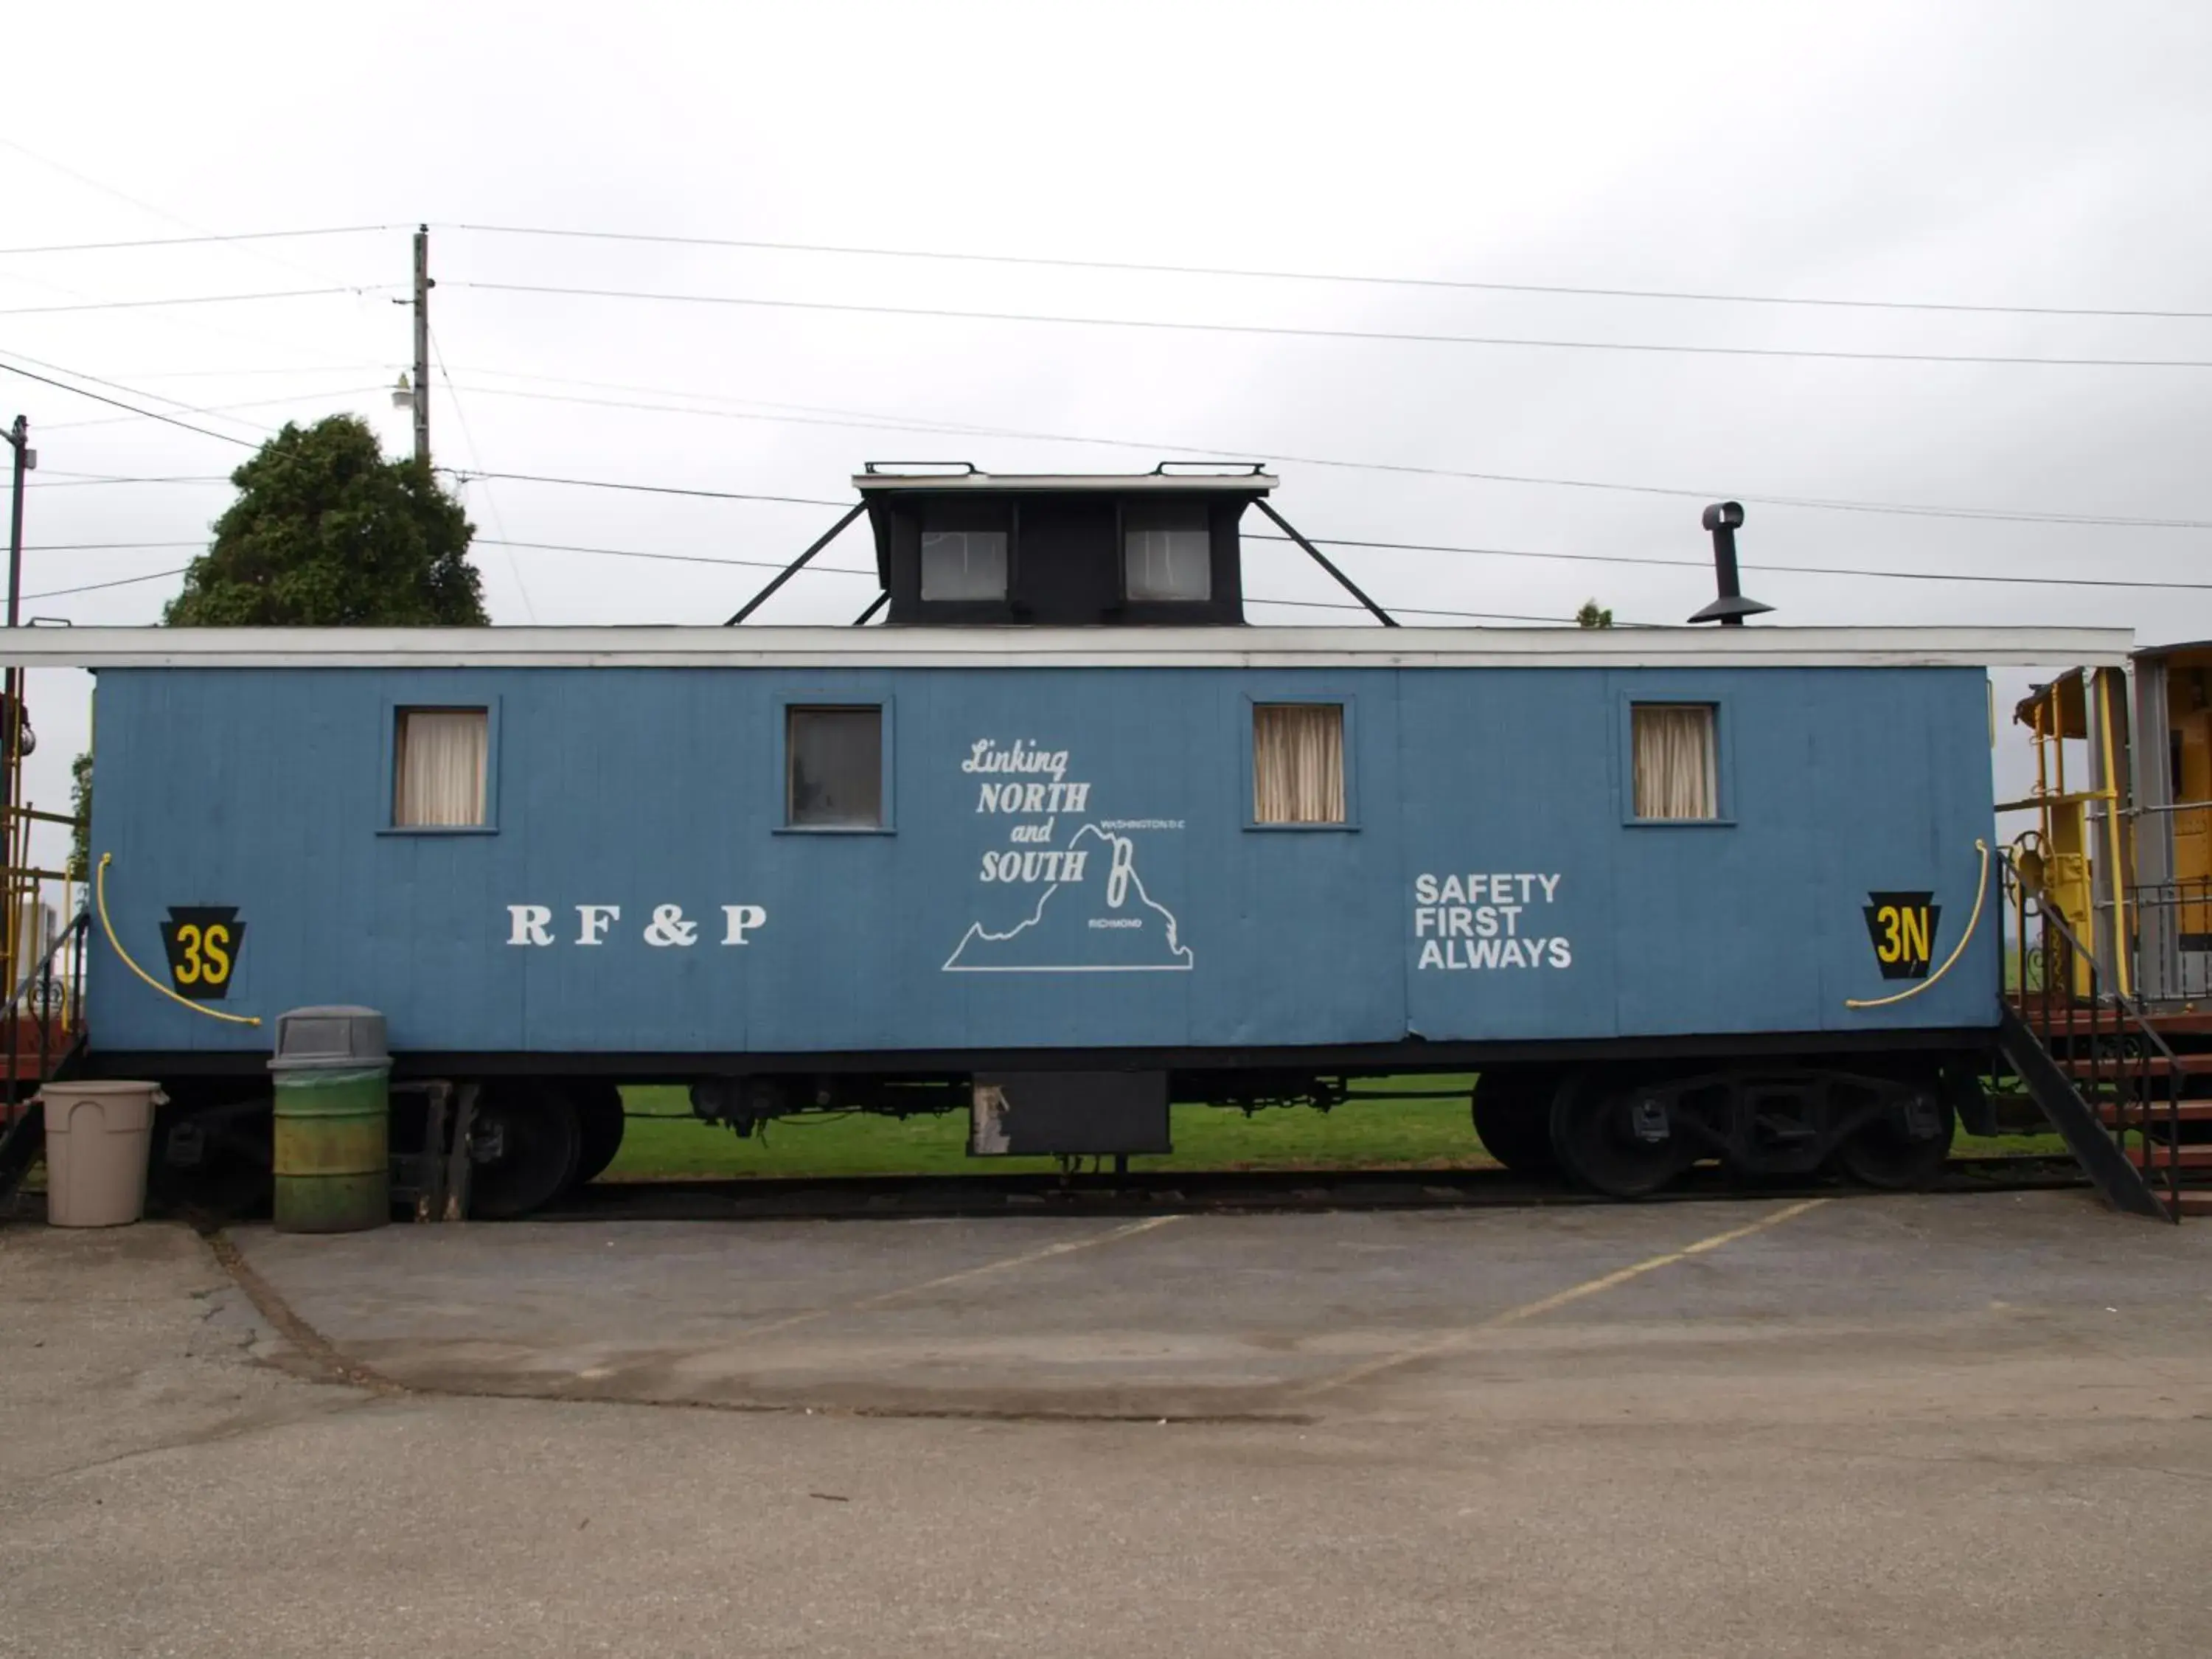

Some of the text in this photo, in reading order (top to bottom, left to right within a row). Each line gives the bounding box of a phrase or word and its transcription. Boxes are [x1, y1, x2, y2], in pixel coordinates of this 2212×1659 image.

[961, 738, 1068, 782] Linking
[975, 783, 1091, 813] NORTH
[1010, 815, 1054, 843] and
[980, 851, 1088, 882] SOUTH
[1415, 873, 1561, 904] SAFETY
[643, 903, 698, 947] &
[720, 905, 767, 945] P
[1415, 905, 1523, 937] FIRST
[1877, 905, 1930, 962] 3N
[175, 923, 230, 985] 3S
[1418, 936, 1572, 970] ALWAYS
